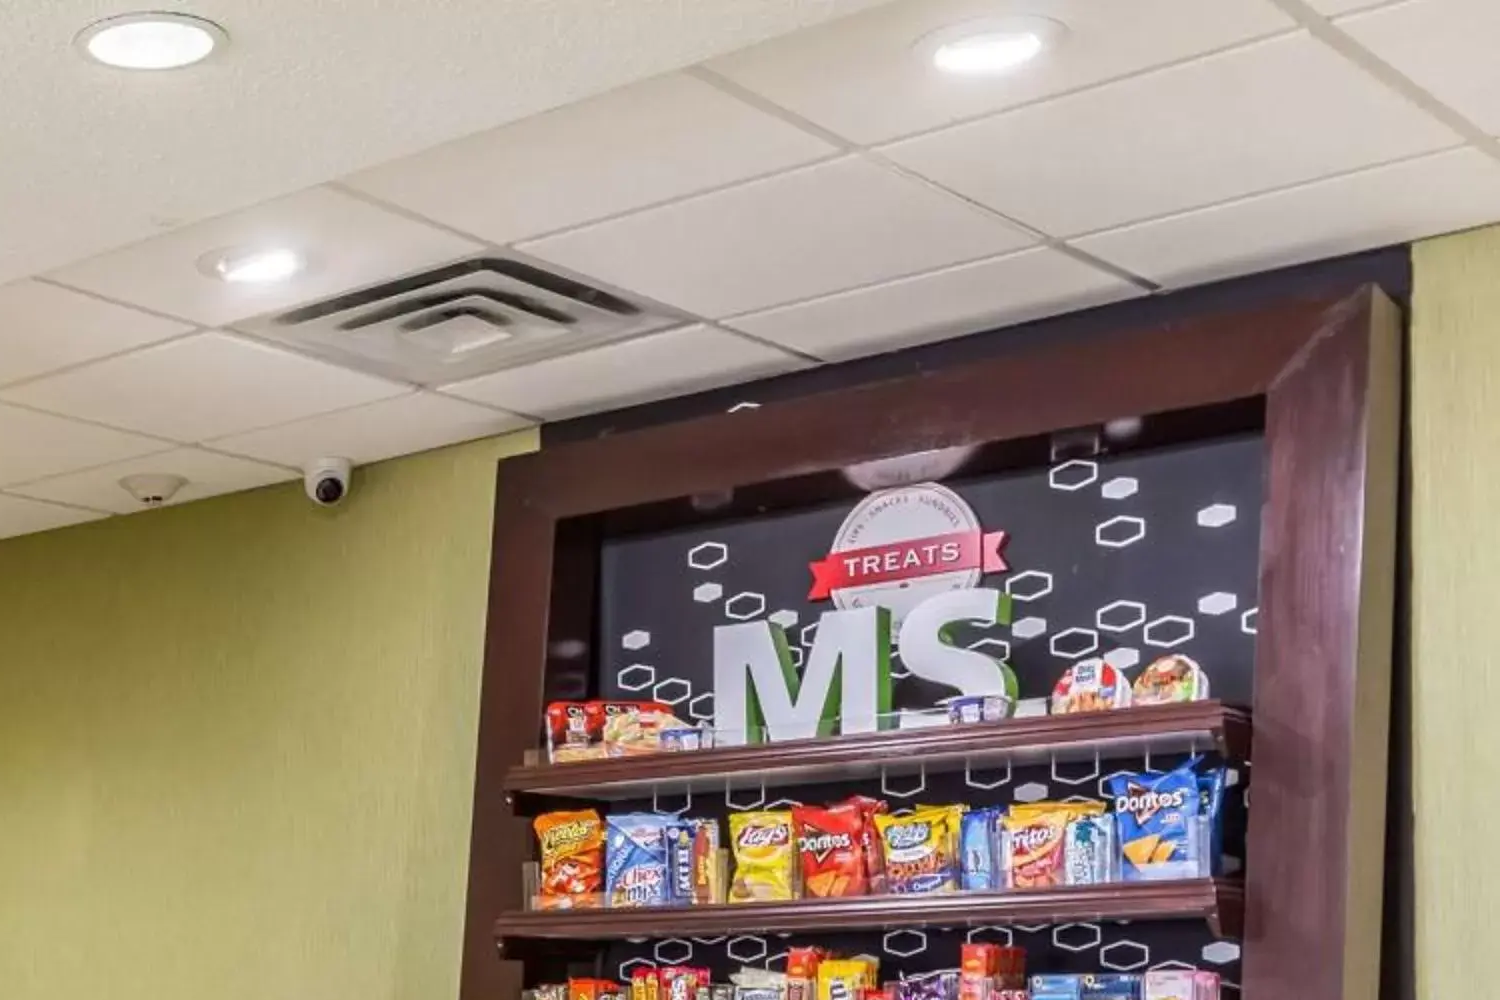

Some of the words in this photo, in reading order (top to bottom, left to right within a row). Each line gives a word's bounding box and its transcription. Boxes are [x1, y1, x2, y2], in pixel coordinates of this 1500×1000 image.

[844, 542, 960, 577] TREATS
[1116, 791, 1183, 812] Doritos
[797, 833, 851, 852] Doritos
